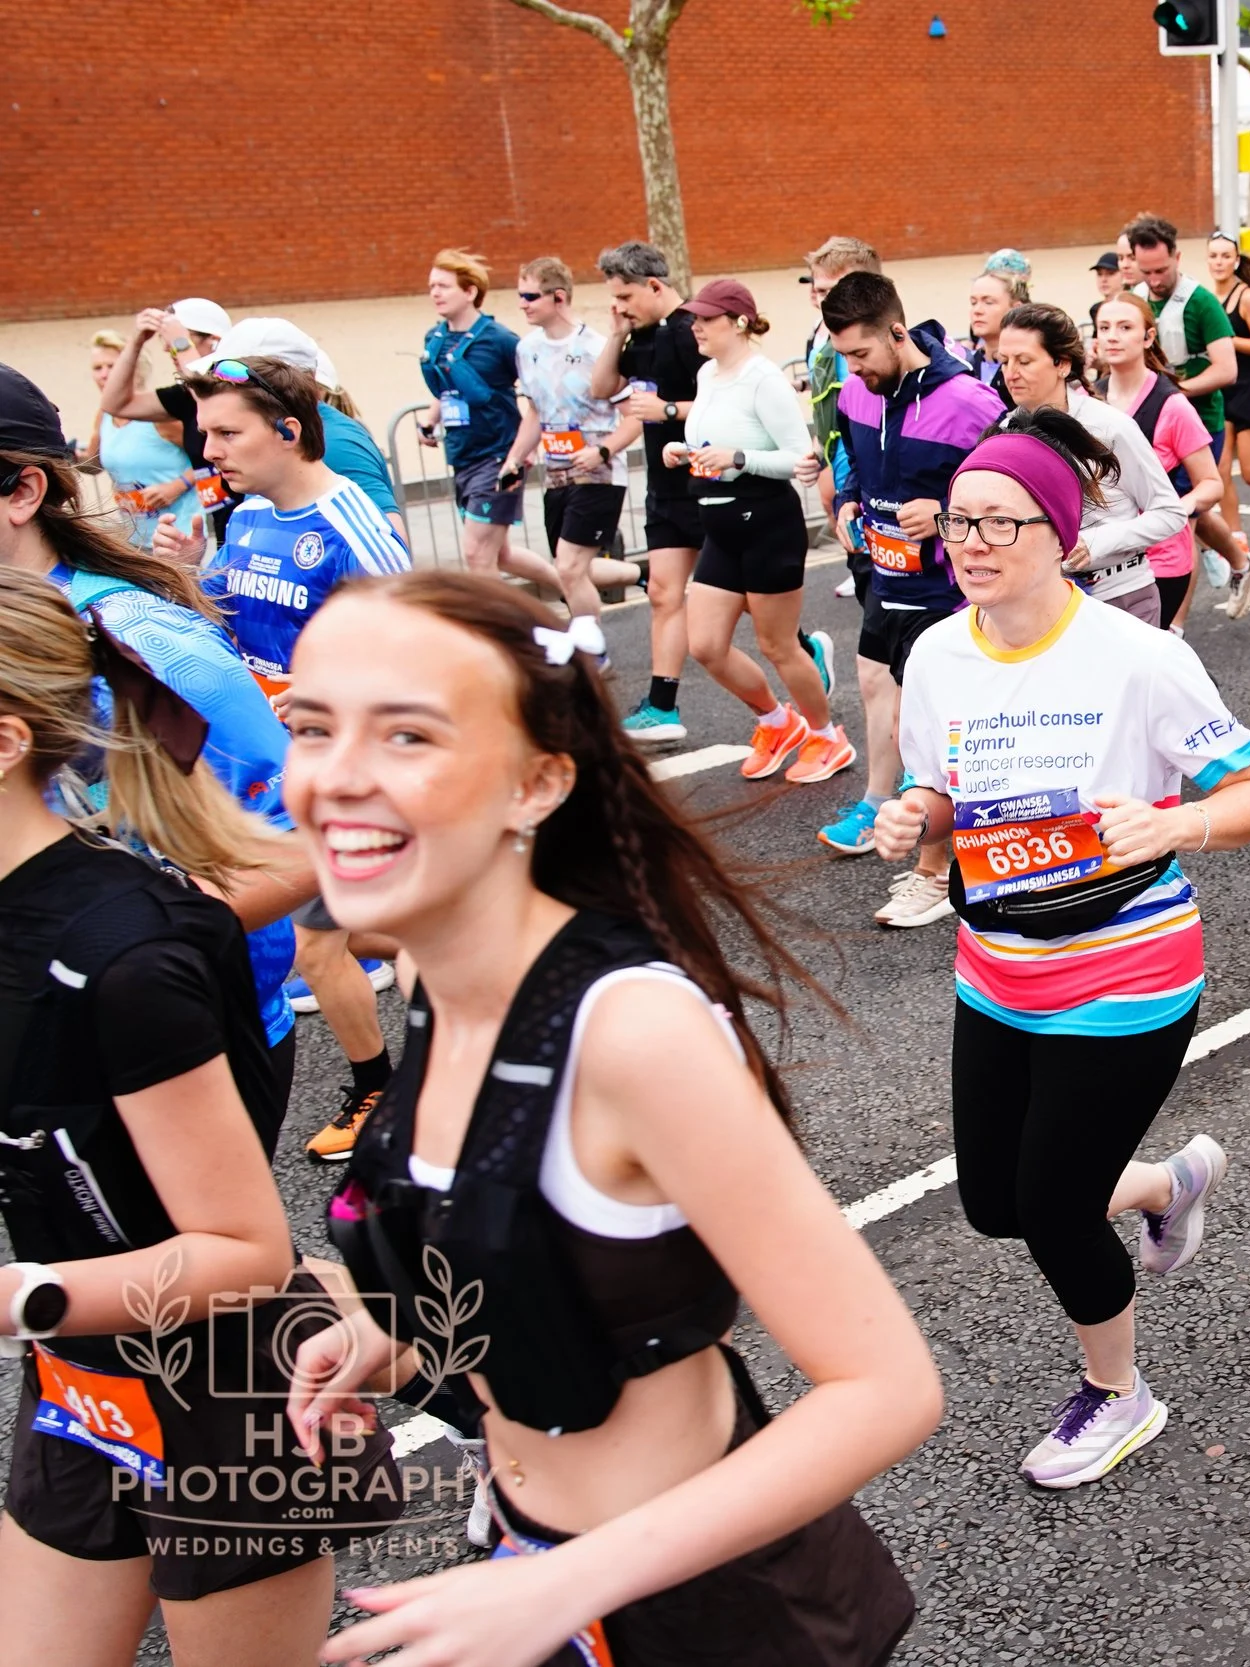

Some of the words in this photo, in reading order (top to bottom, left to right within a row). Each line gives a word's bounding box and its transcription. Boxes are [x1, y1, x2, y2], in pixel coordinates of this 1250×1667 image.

[871, 542, 907, 569] 8509
[227, 568, 308, 610] SAMSUNG
[967, 711, 1036, 734] ymchwil
[1040, 712, 1103, 726] canser
[965, 736, 1015, 754] cymru
[964, 756, 1016, 773] cancer
[1018, 752, 1094, 769] research
[966, 777, 1010, 794] wales
[1000, 794, 1051, 813] SWANSEA
[956, 827, 1032, 850] RHIANNON
[986, 832, 1074, 875] 6936
[996, 866, 1081, 896] #RUNSWANSEA
[64, 1169, 99, 1212] INOXTO
